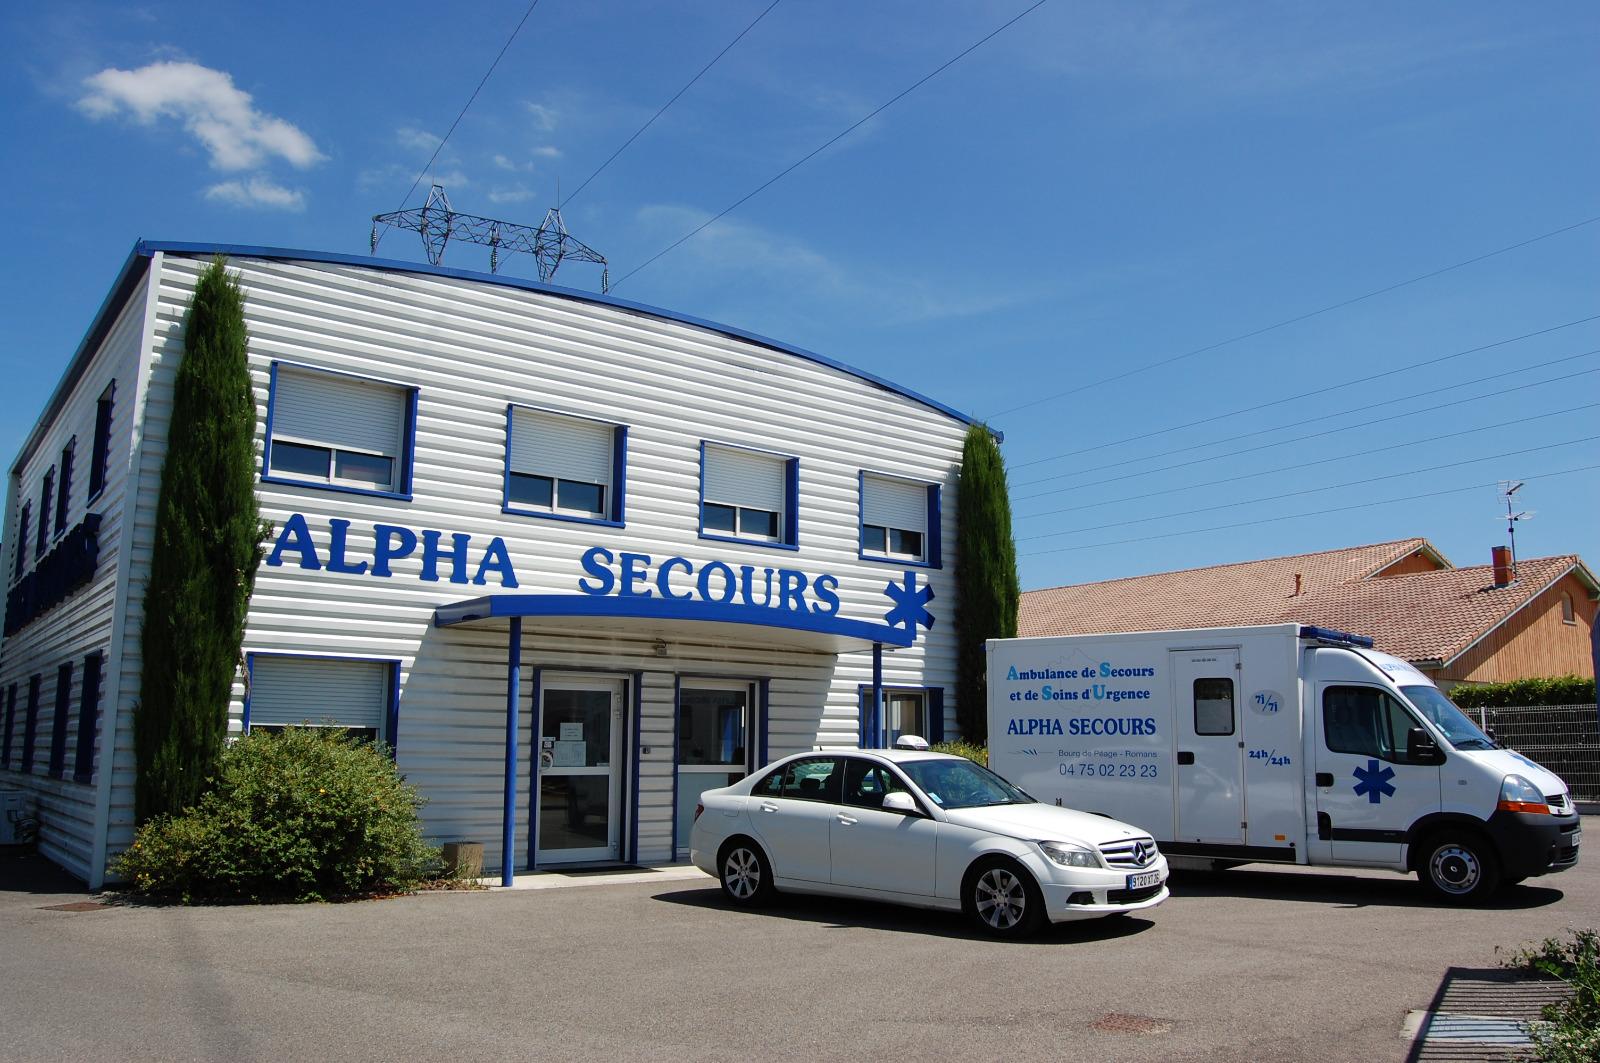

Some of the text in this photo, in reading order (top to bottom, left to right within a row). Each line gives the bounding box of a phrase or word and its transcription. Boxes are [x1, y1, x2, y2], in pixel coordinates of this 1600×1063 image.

[266, 513, 840, 617] ALPHA SECOURS
[1006, 662, 1155, 680] Ambulance de Secours
[1010, 684, 1151, 702] et de Soins d'Urgence
[1007, 717, 1156, 735] ALPHA SECOURS
[1125, 750, 1158, 758] Romans
[1059, 763, 1158, 777] 04 75 02 23 23
